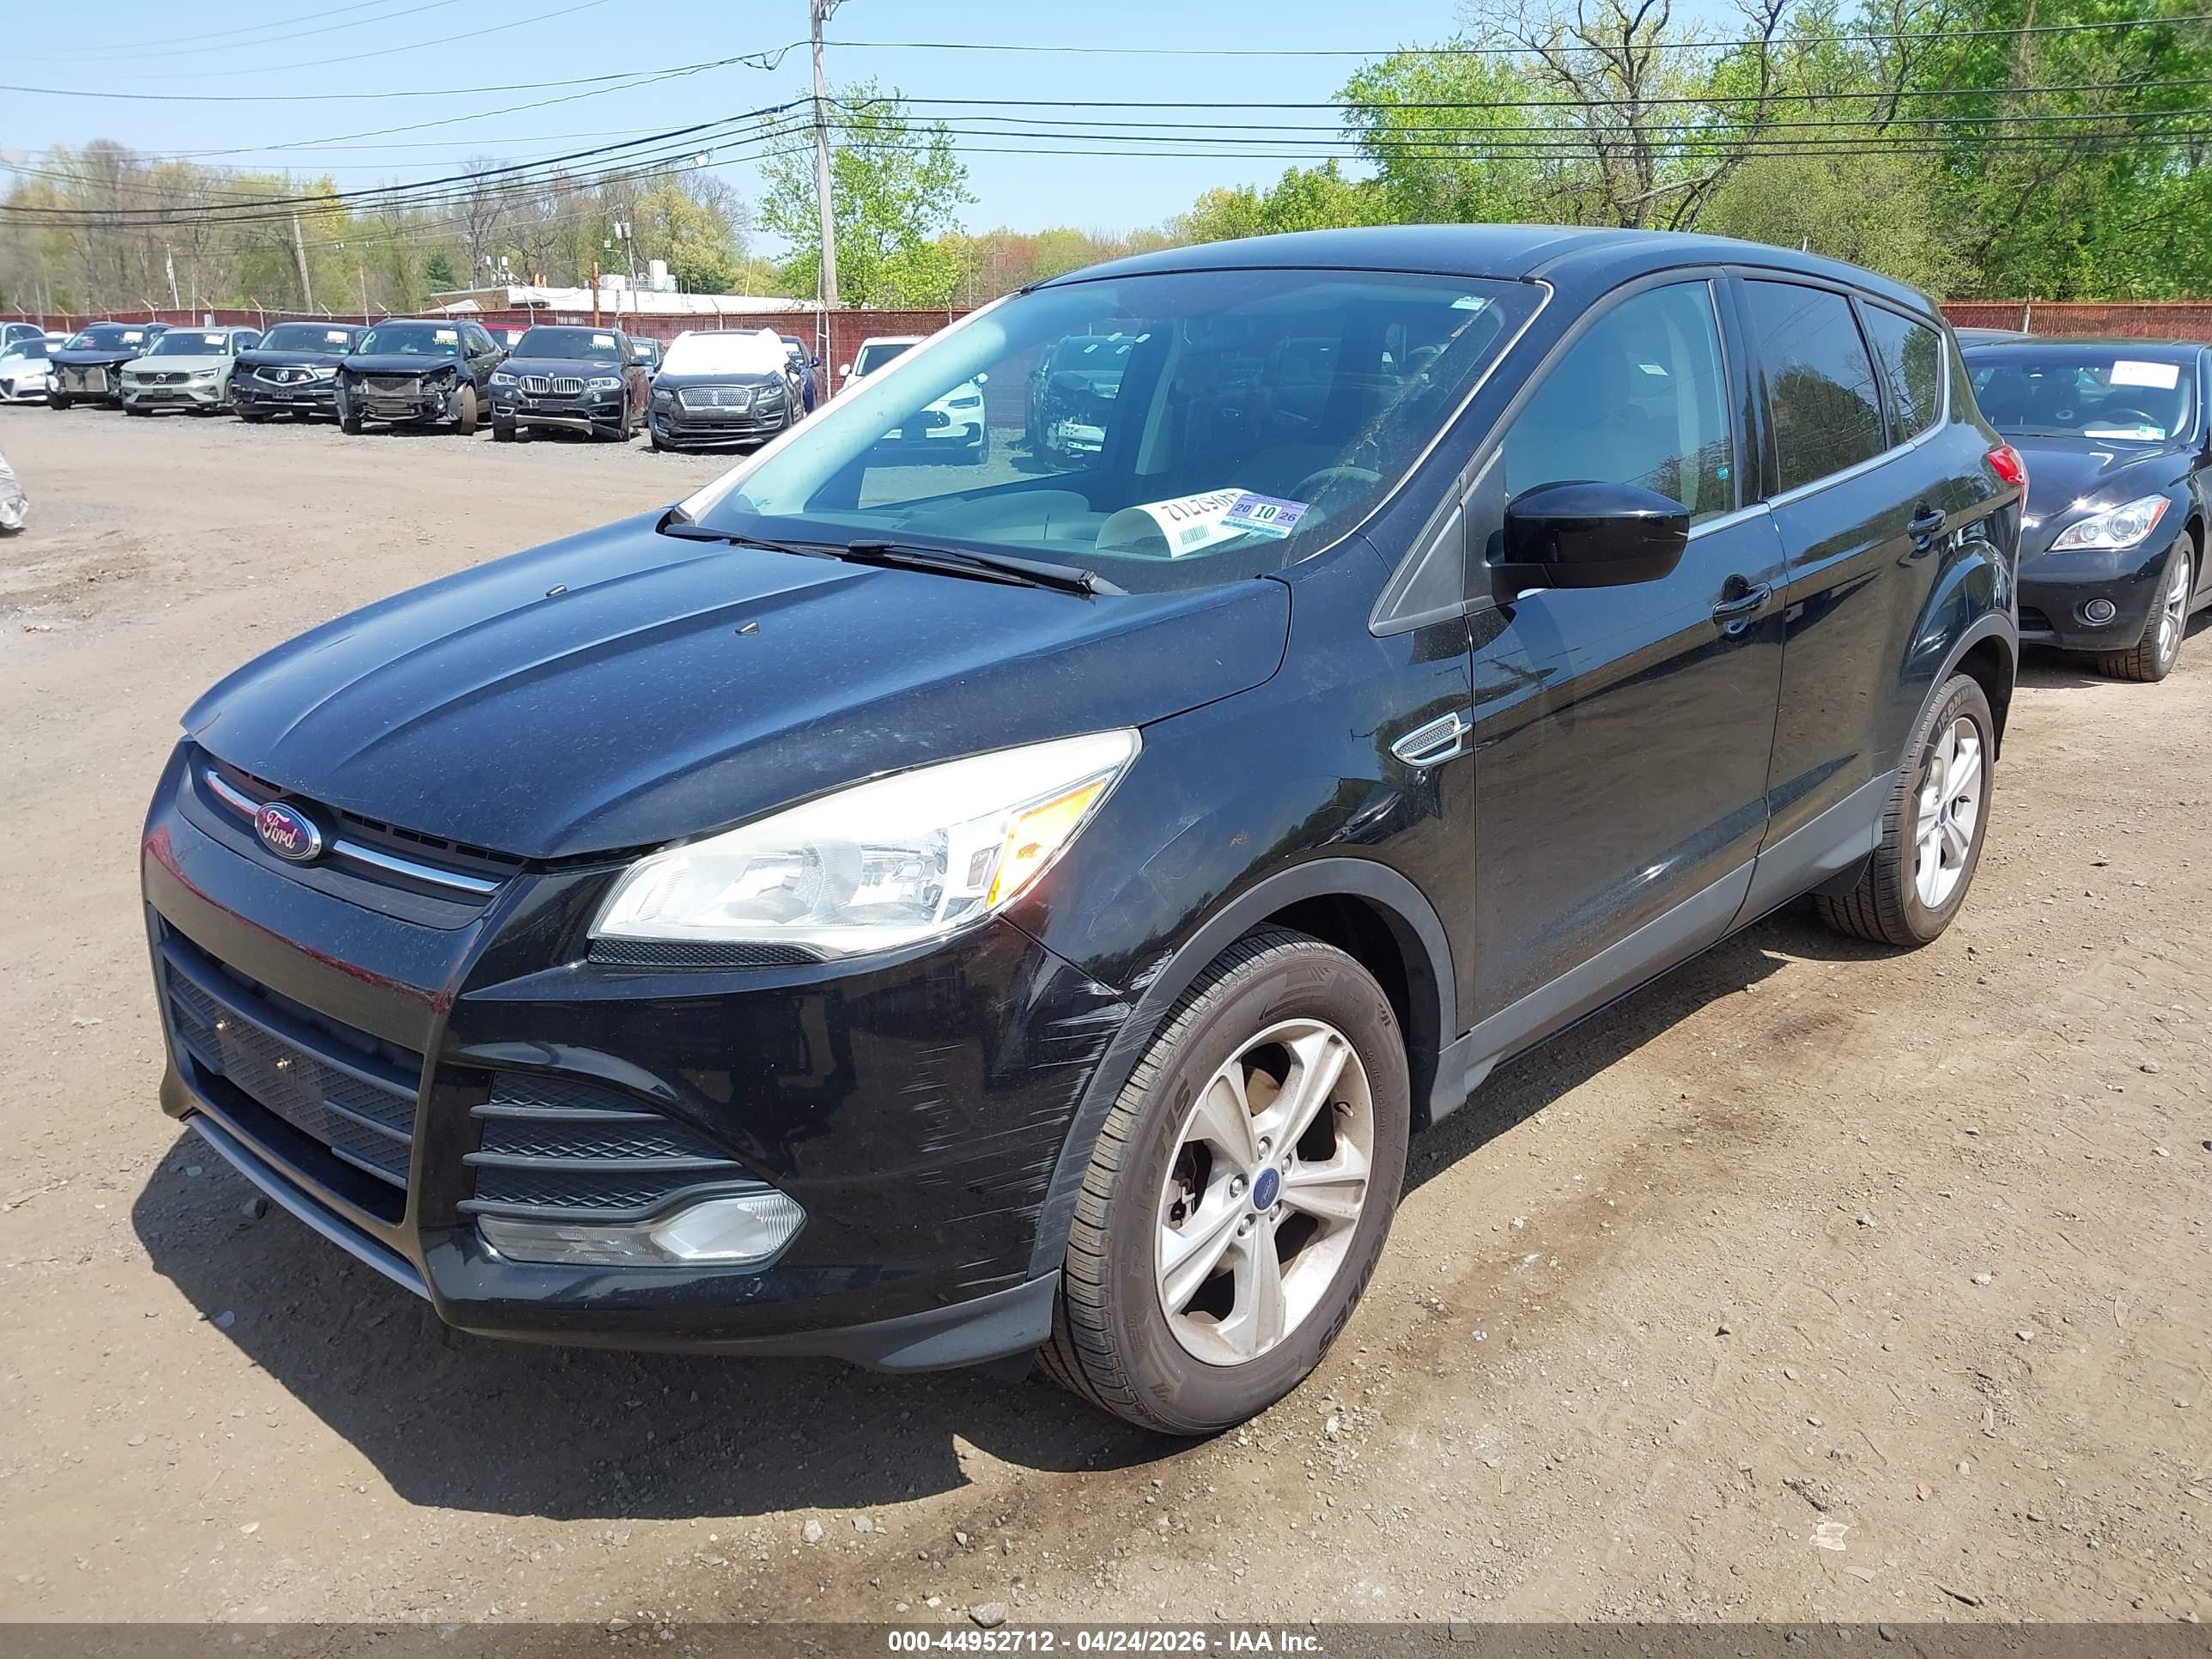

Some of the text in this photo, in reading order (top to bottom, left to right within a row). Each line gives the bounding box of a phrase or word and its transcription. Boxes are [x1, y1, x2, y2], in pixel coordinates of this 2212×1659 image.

[1234, 503, 1297, 522] 20 10 26
[263, 810, 299, 849] Ford
